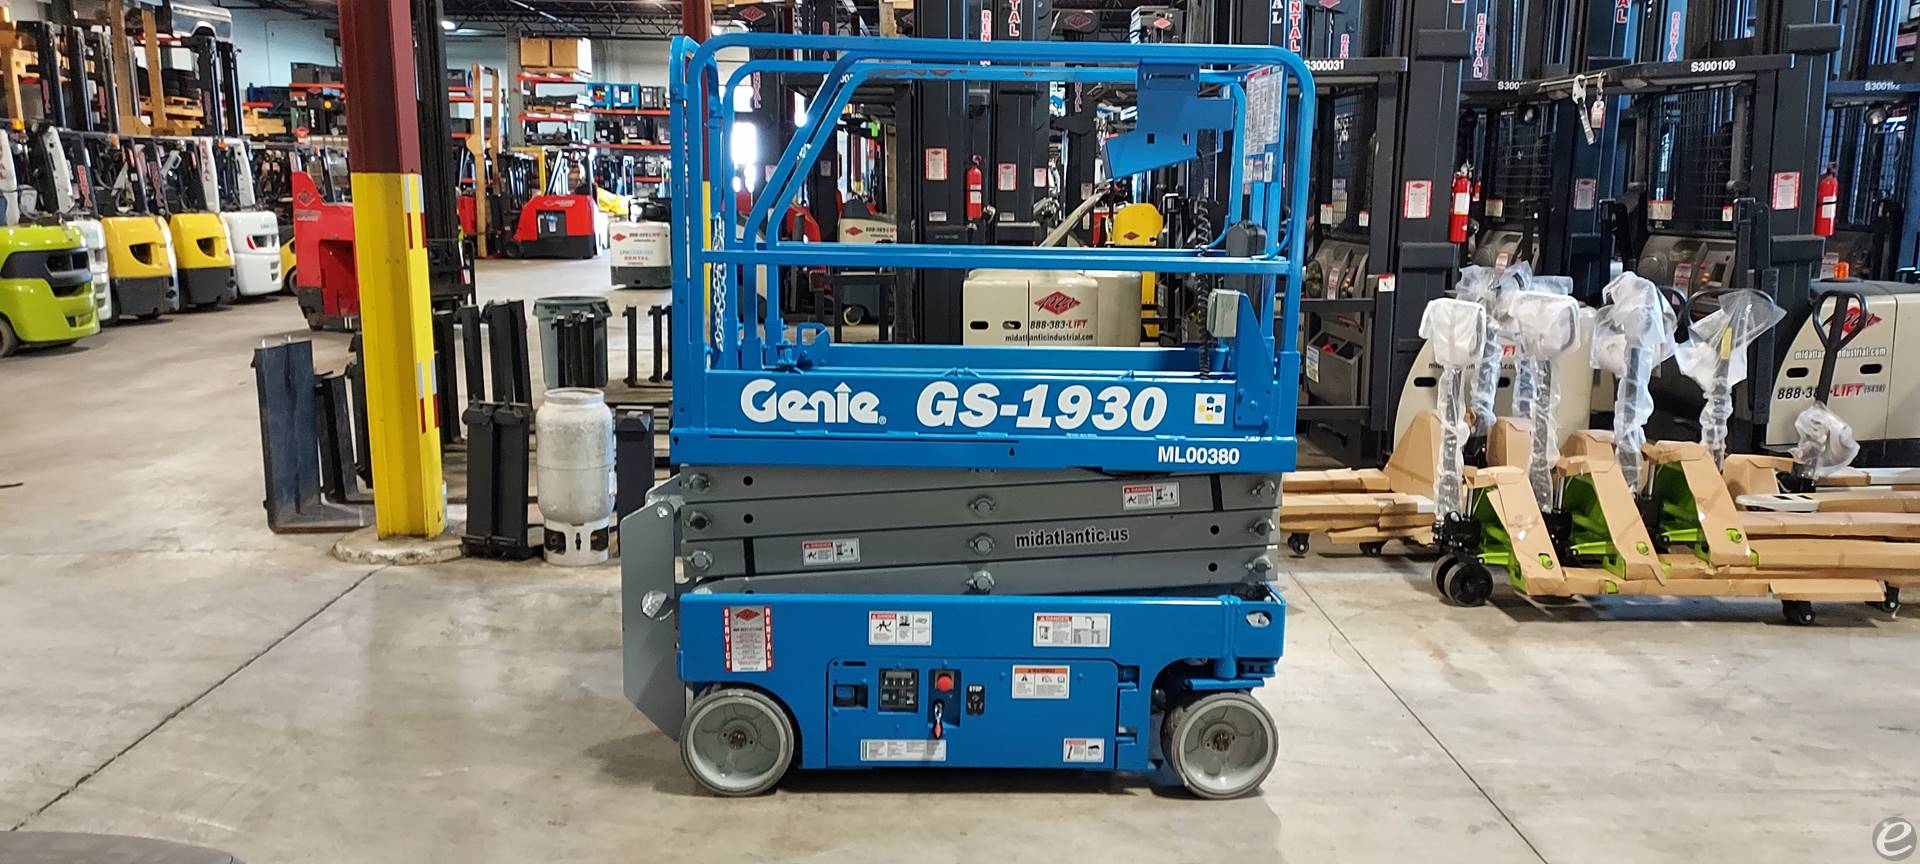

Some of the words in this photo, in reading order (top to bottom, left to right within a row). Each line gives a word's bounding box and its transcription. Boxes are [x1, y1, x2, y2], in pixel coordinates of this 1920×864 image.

[1473, 13, 1487, 78] RENTAL
[1690, 59, 1736, 73] S300109
[741, 379, 880, 424] Genie
[916, 381, 1168, 431] GS-1930
[1158, 446, 1240, 465] ML00380
[1016, 527, 1129, 548] midatlantic.us
